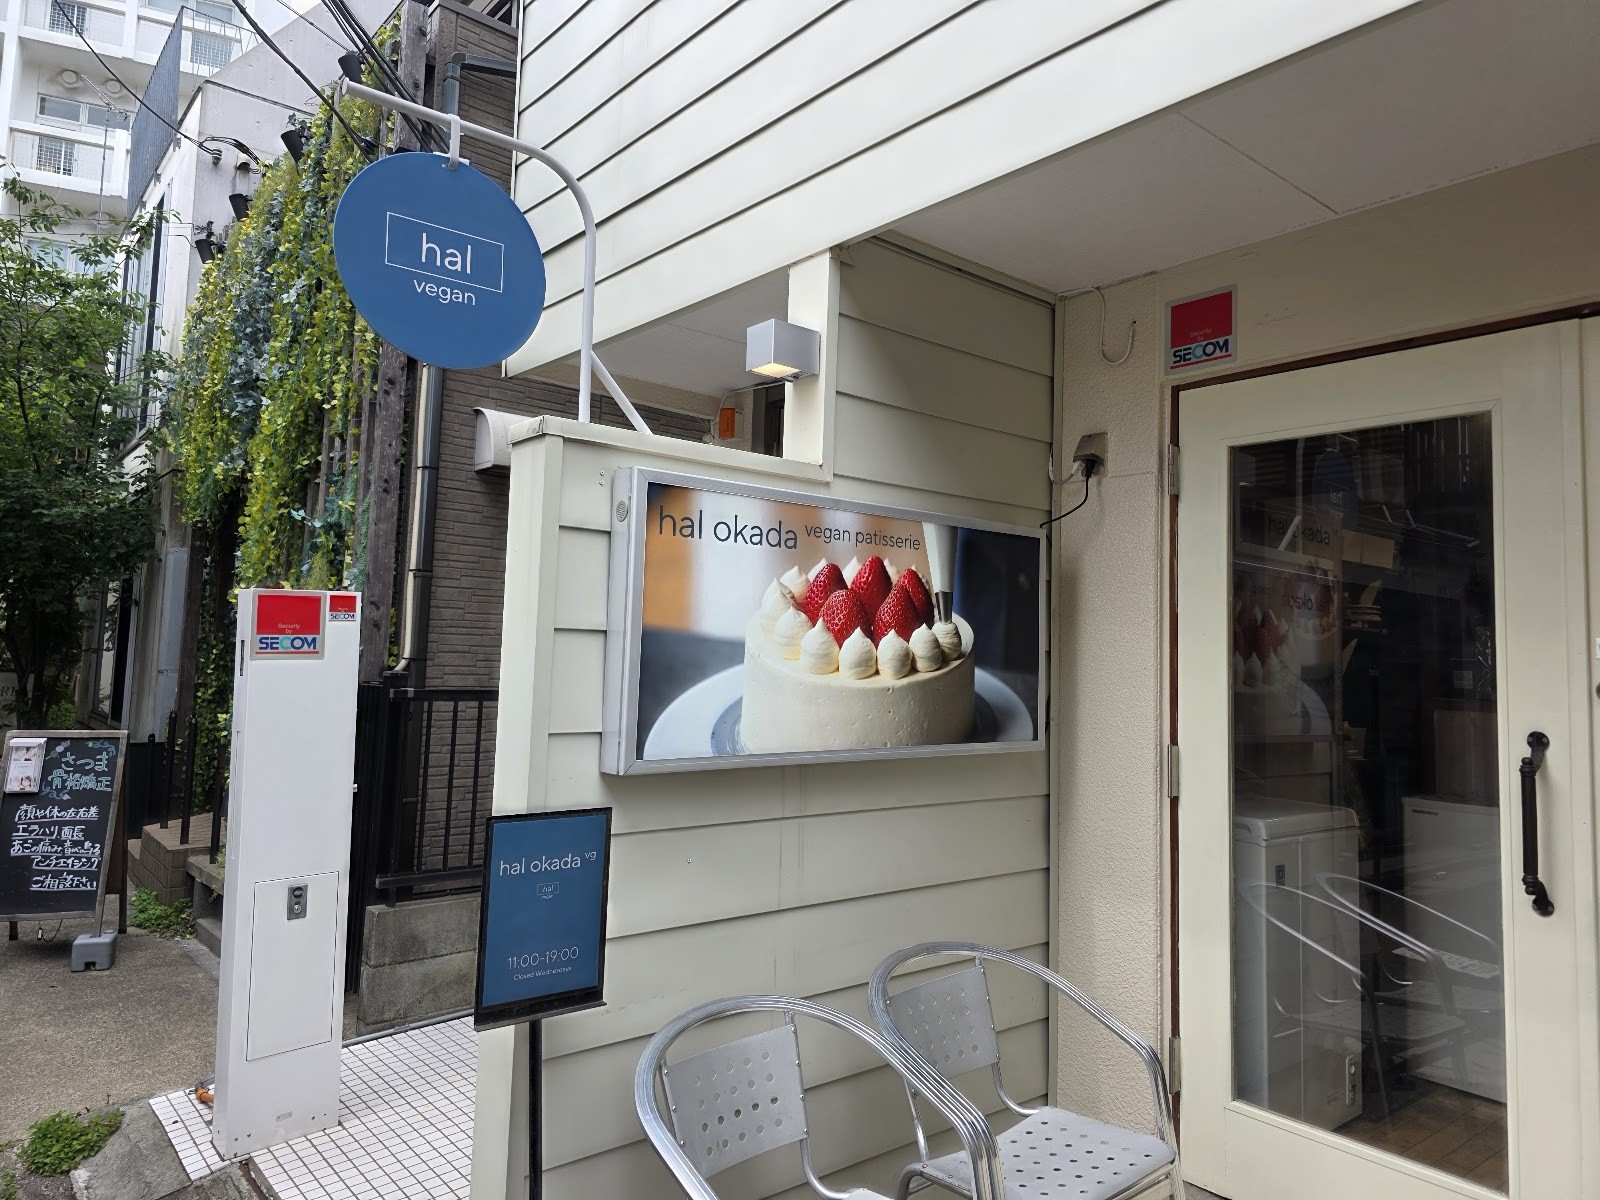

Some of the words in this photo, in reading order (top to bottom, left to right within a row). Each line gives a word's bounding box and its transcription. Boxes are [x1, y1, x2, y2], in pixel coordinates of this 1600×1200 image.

[421, 232, 472, 275] hal
[413, 279, 476, 306] vegan
[1172, 338, 1229, 365] SECOM
[659, 504, 703, 539] hal
[713, 514, 798, 550] okada
[804, 523, 851, 544] vegan
[855, 529, 921, 551] patisserie
[278, 623, 301, 631] Security
[258, 636, 317, 651] SECOM
[61, 751, 109, 772] さつま
[499, 857, 525, 876] hal
[530, 853, 581, 873] okada
[584, 851, 597, 861] vg
[508, 946, 579, 970] 11:00-19:00
[513, 971, 535, 981] Closed
